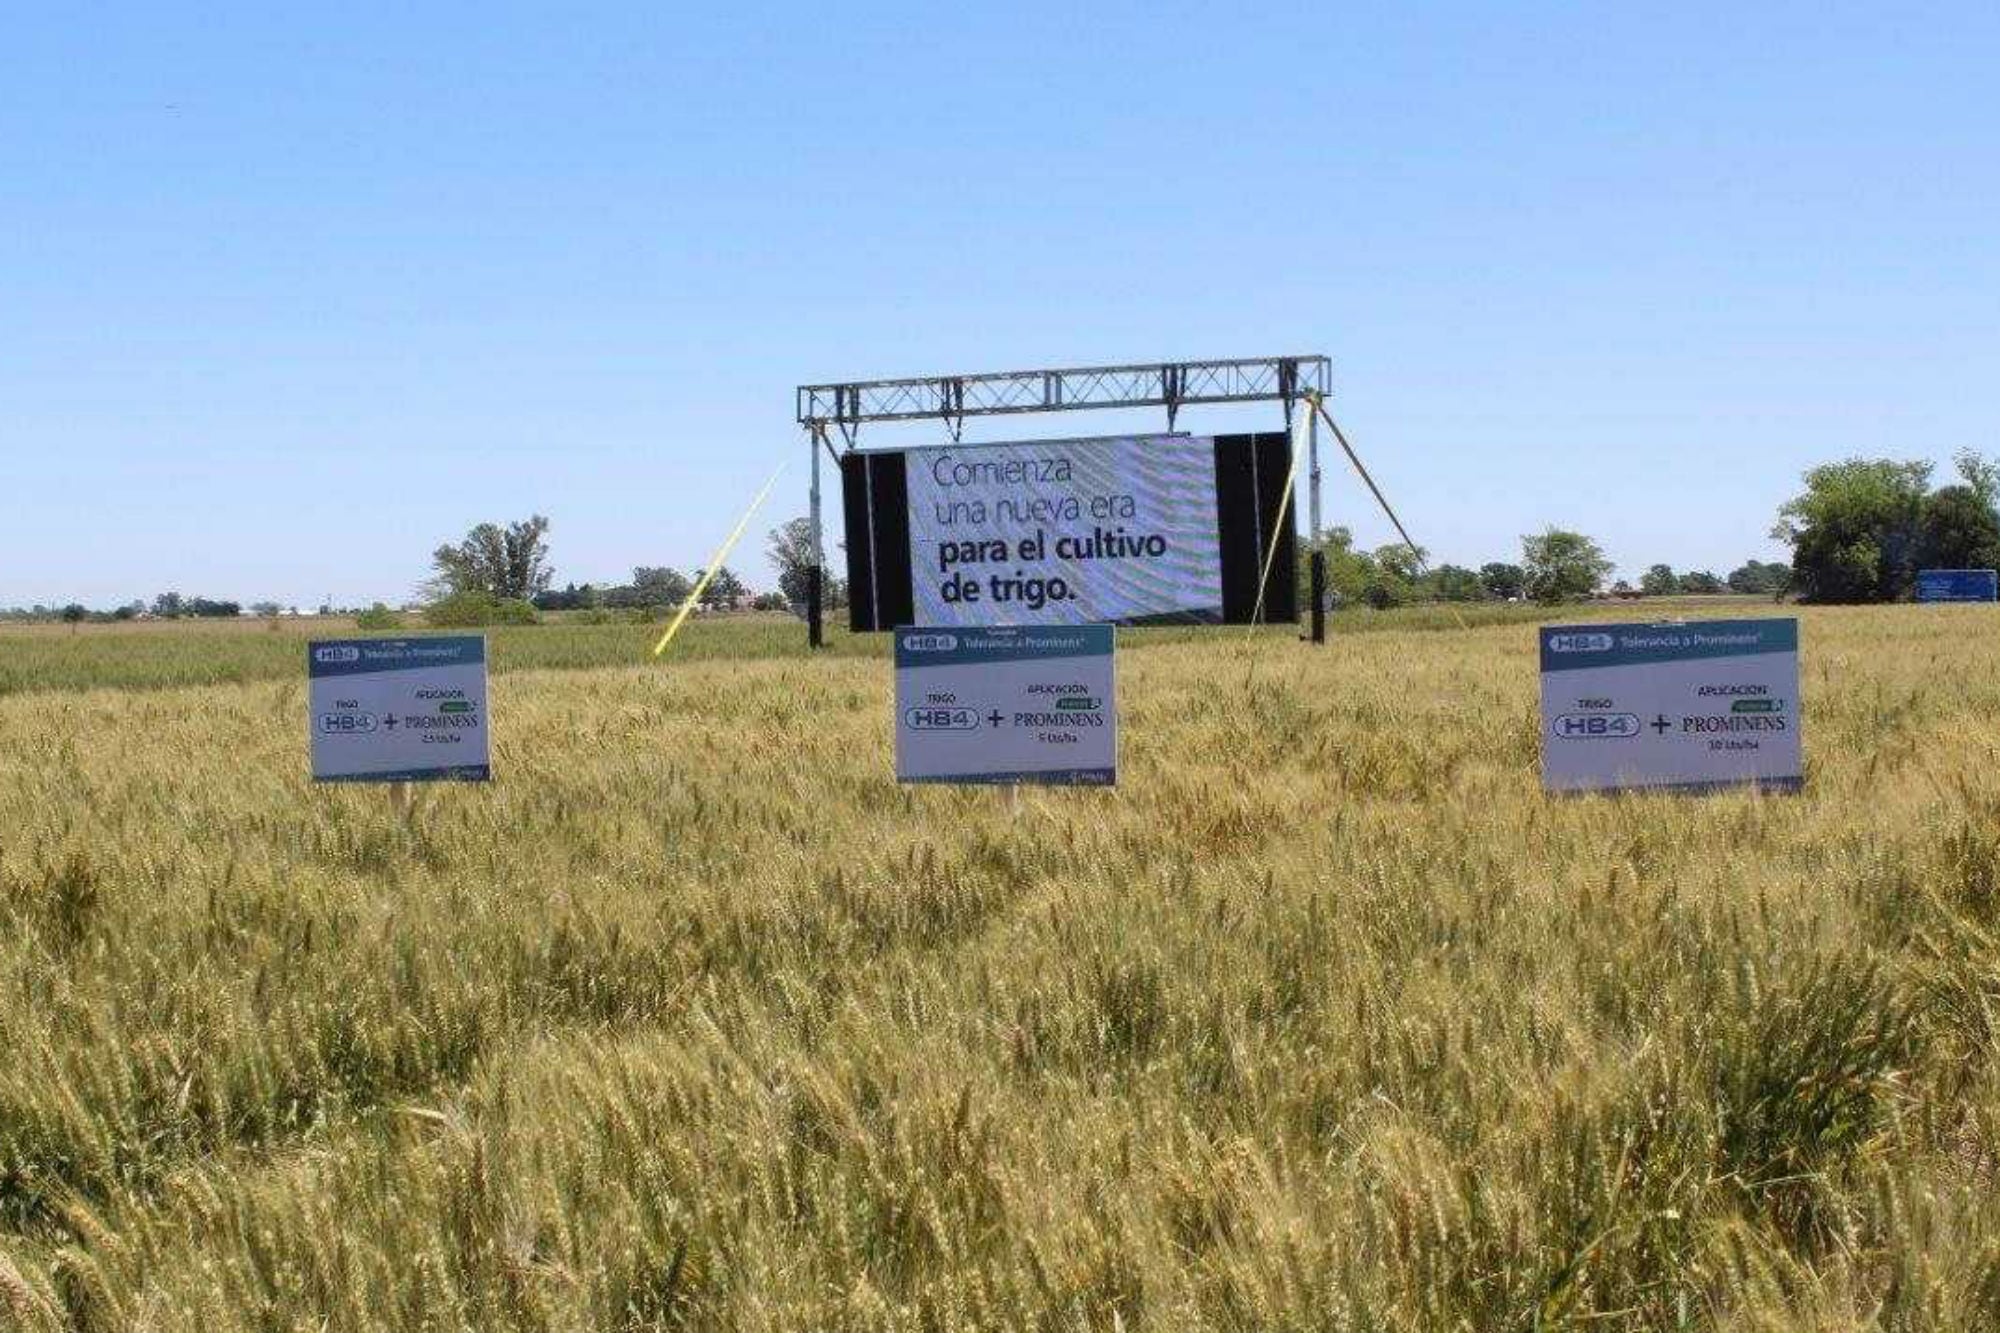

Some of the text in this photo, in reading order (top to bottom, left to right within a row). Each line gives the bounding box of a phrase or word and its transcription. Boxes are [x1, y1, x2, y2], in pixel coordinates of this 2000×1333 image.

[933, 456, 1073, 486] Comienza
[935, 493, 1136, 525] una nueva era
[938, 527, 1167, 572] para el cultivo
[941, 571, 1076, 610] de trigo.
[325, 715, 370, 730] HB4
[405, 714, 479, 729] PROMINENS
[915, 710, 969, 727] HB4
[1014, 711, 1104, 727] PROMINENS
[1565, 717, 1628, 734] HB4
[1682, 715, 1786, 732] PROMINENS
